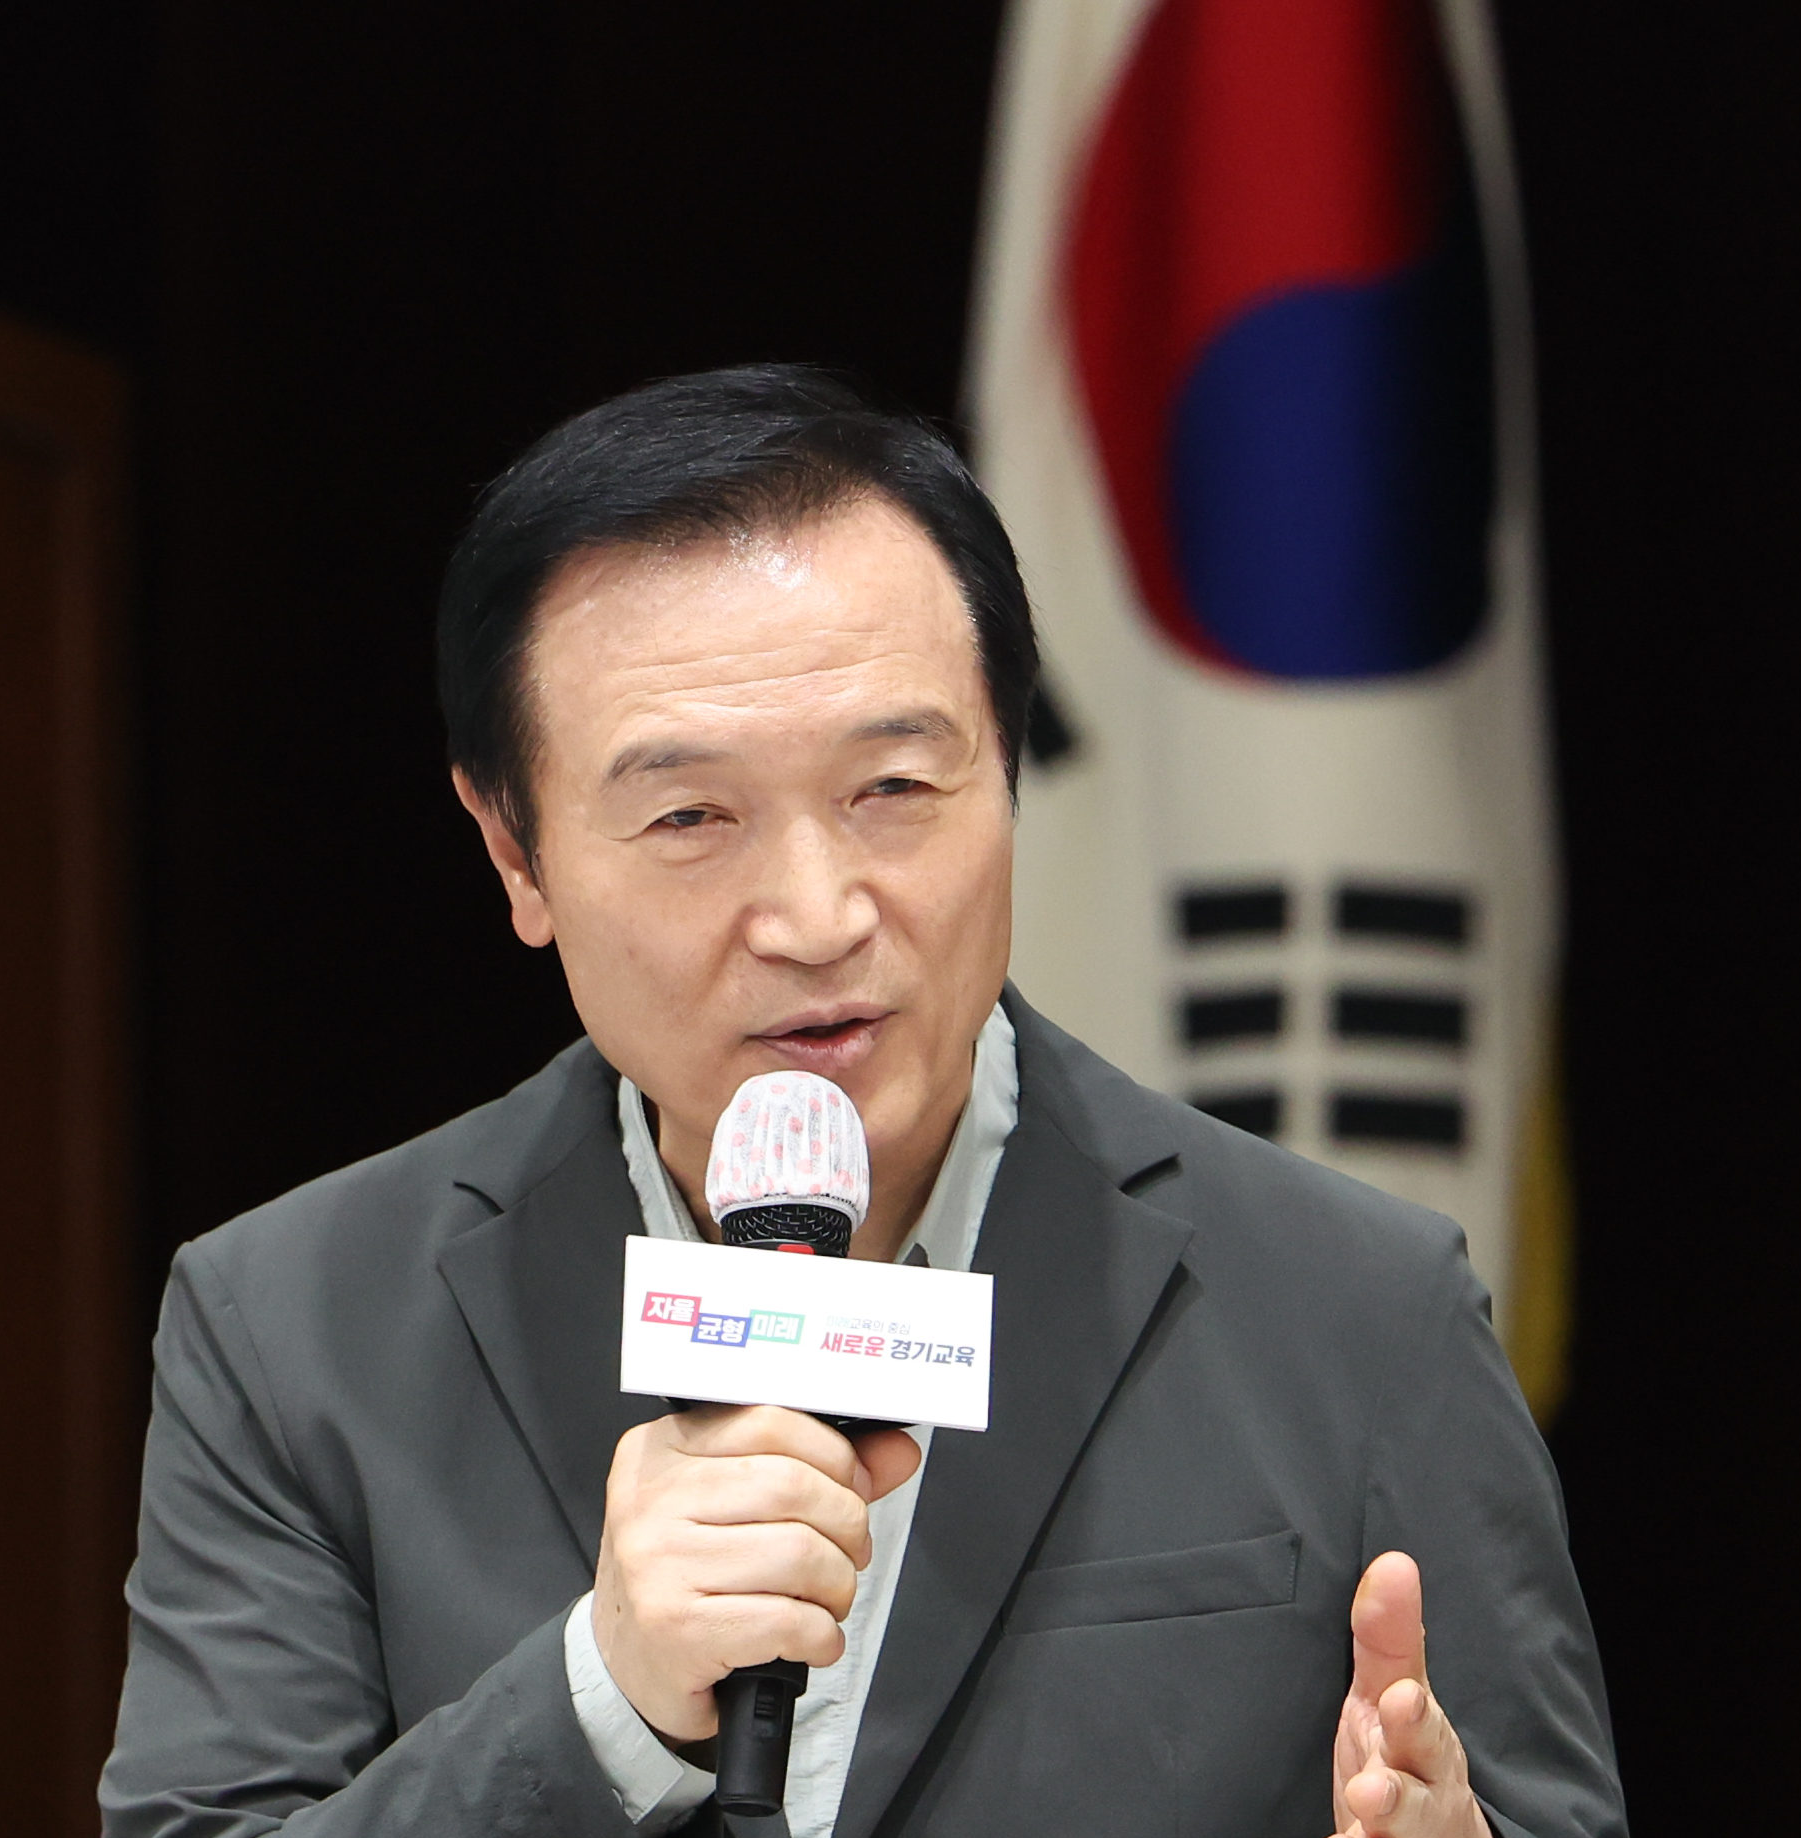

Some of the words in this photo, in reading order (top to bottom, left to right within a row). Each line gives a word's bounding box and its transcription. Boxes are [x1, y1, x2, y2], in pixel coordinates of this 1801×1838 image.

[646, 1296, 695, 1323] 자율
[697, 1316, 746, 1344] 균형
[751, 1314, 800, 1341] 미래
[826, 1315, 885, 1332] 미래교육의
[887, 1321, 911, 1336] 중심
[819, 1331, 886, 1358] 새로운
[890, 1338, 976, 1367] 경기교육
